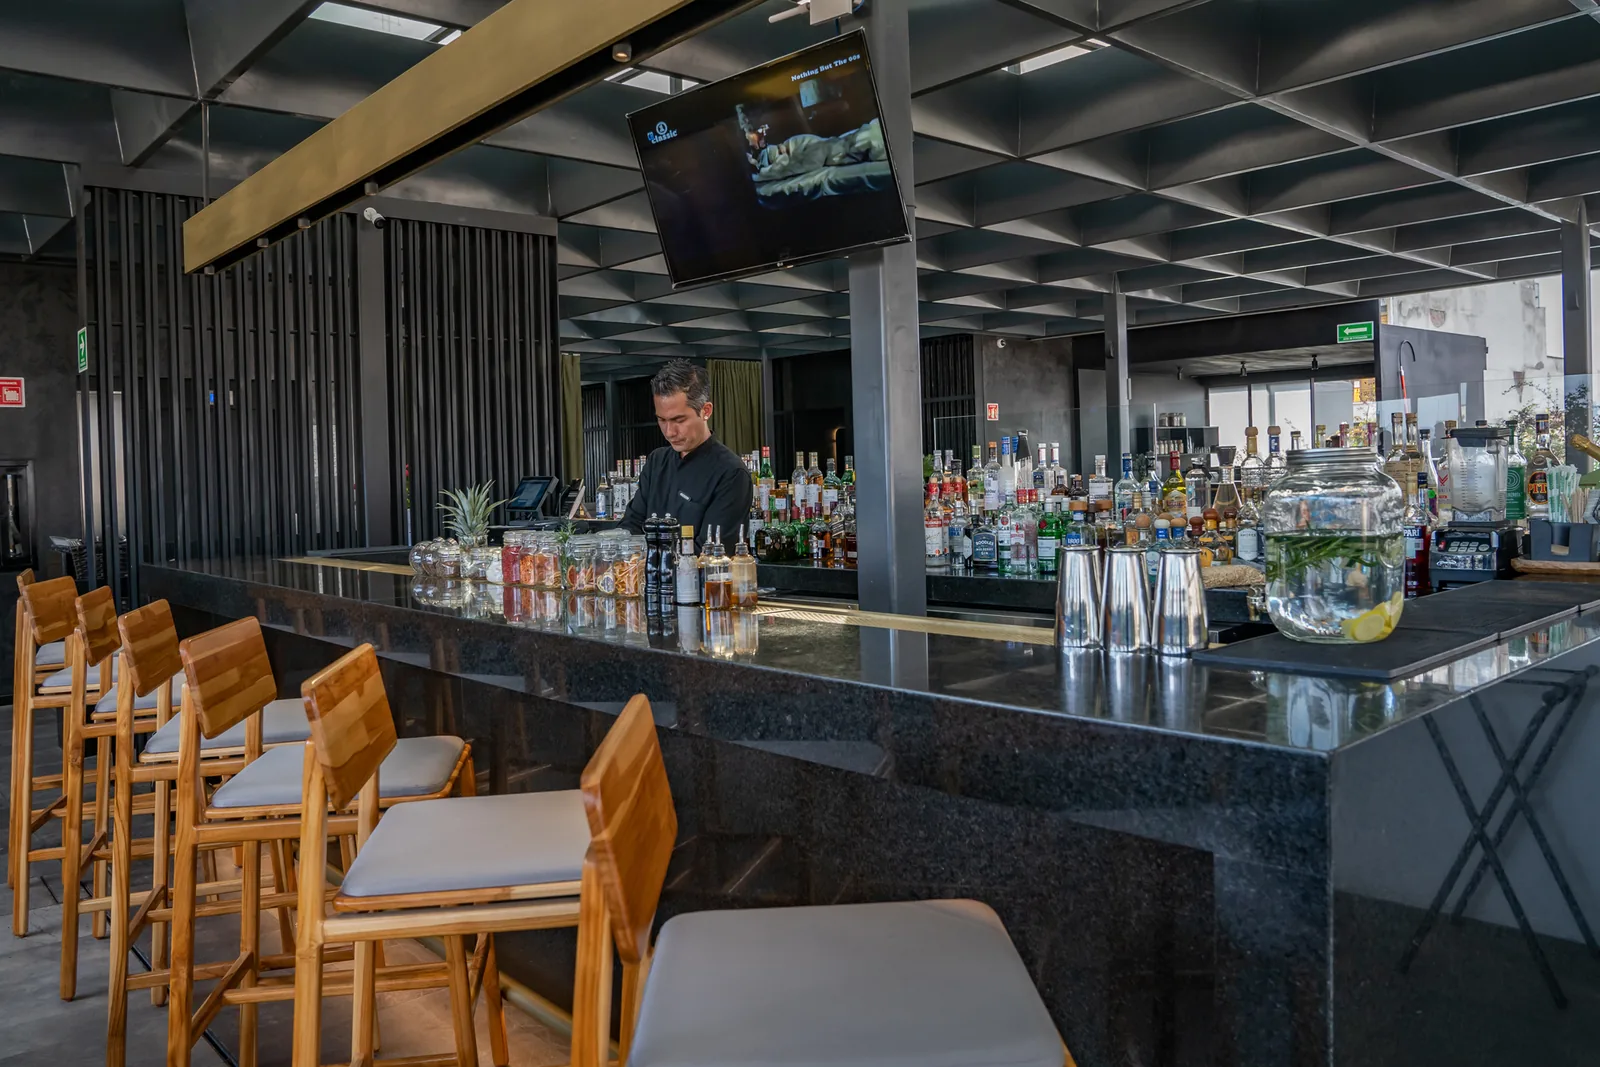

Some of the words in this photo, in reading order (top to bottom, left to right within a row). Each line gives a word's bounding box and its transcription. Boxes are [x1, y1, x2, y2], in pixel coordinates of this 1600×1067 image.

[791, 67, 819, 82] Nothing
[820, 63, 833, 72] But
[833, 58, 848, 67] The
